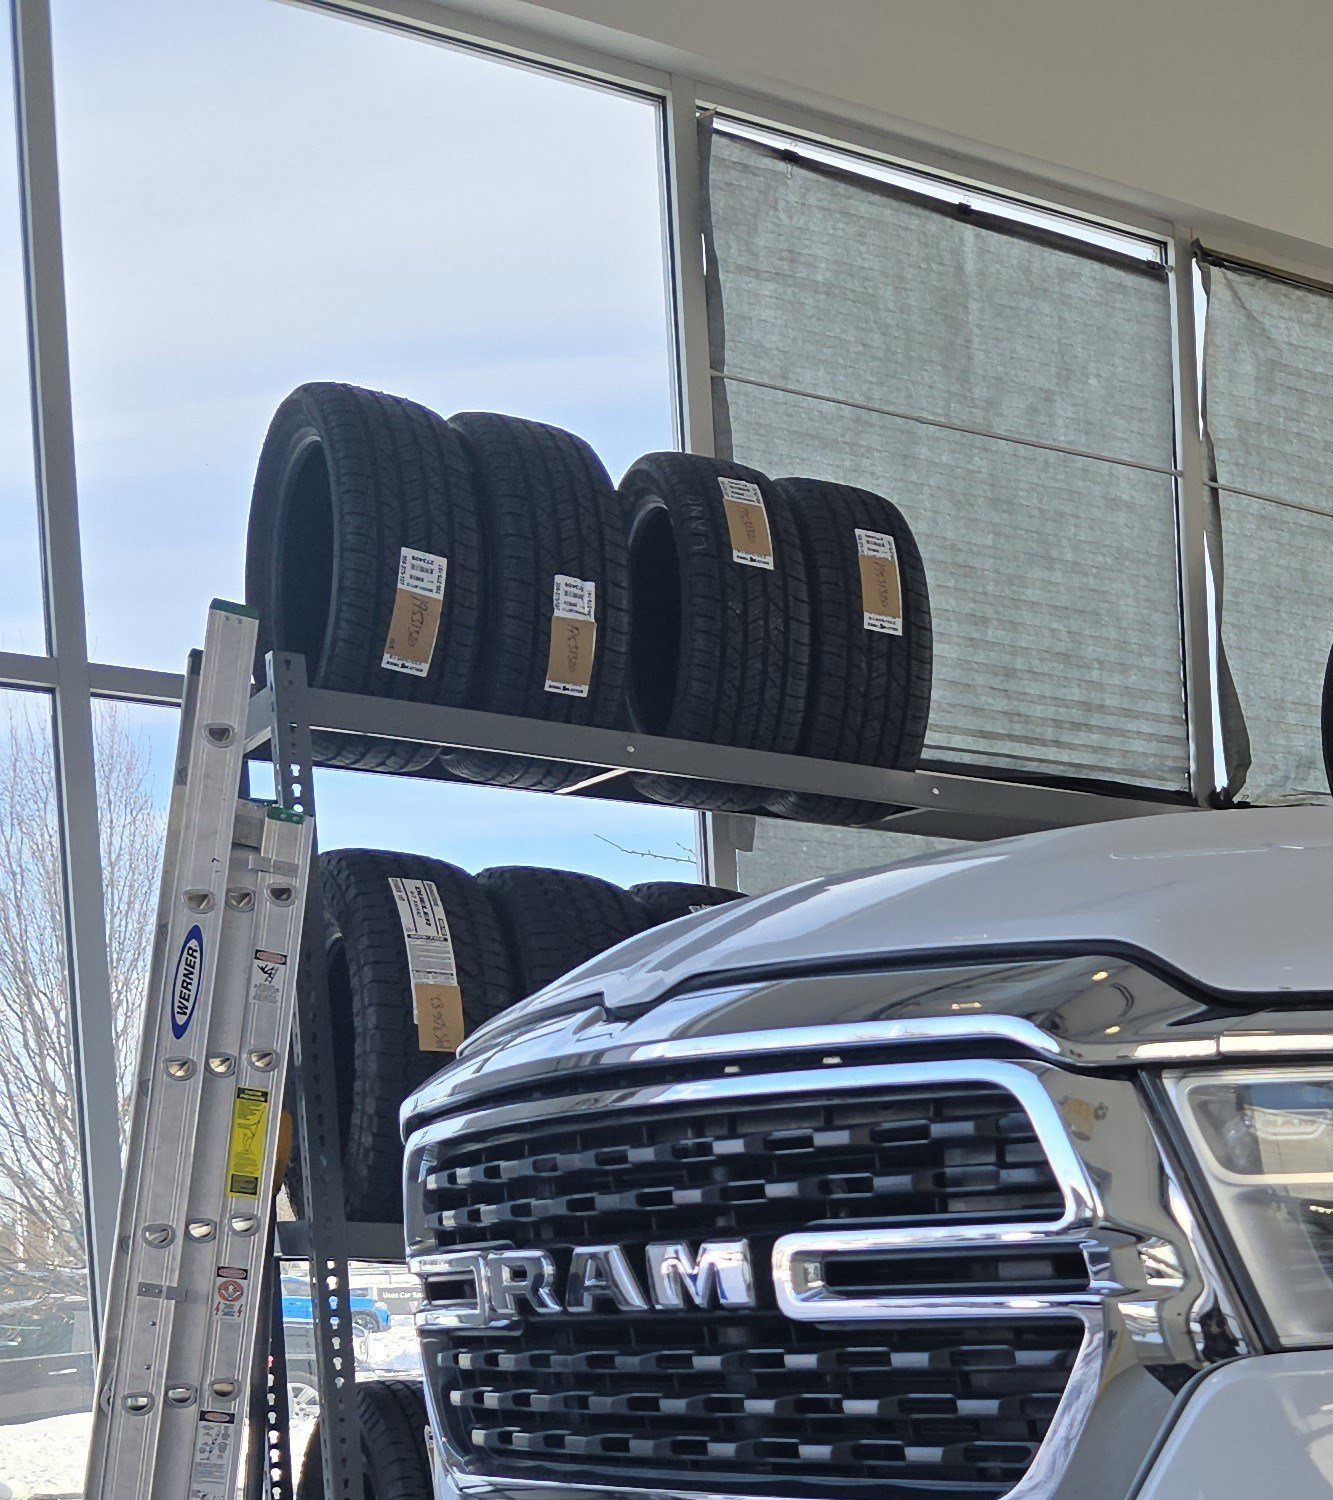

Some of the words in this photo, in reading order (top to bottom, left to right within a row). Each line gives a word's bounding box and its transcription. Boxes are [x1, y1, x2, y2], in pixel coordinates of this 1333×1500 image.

[414, 885, 432, 927] DUELER
[176, 945, 199, 1017] WERNER
[487, 1239, 754, 1313] RAM
